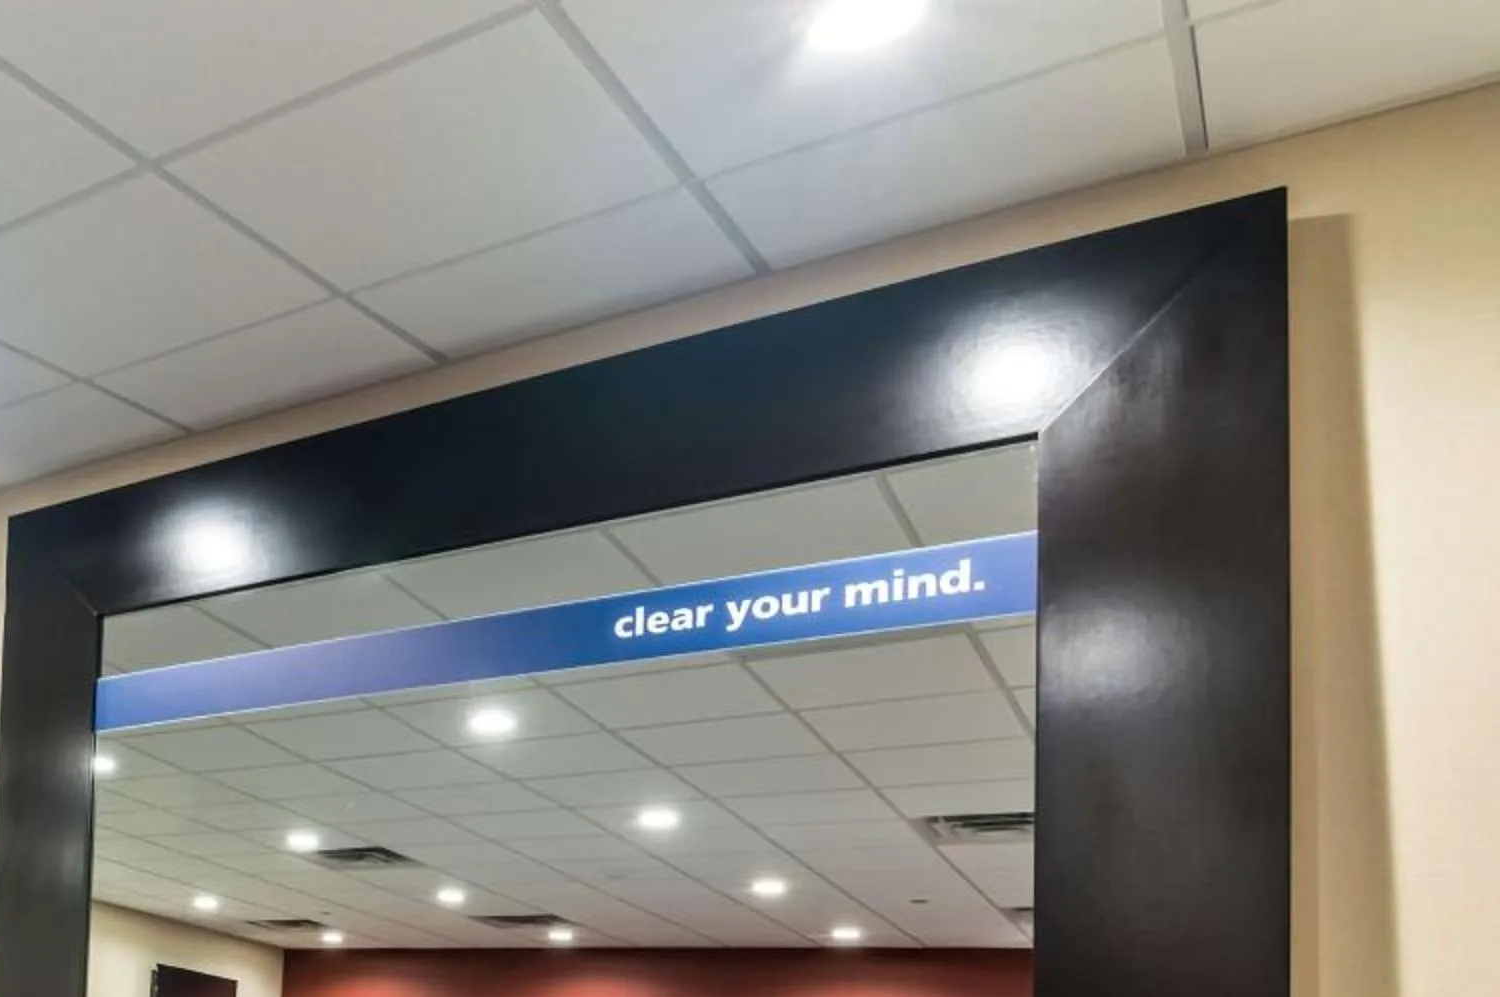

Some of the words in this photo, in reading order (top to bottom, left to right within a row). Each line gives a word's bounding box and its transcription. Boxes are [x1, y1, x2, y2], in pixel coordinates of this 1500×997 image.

[613, 603, 713, 639] clear
[725, 586, 831, 632] your
[844, 558, 986, 608] mind.
